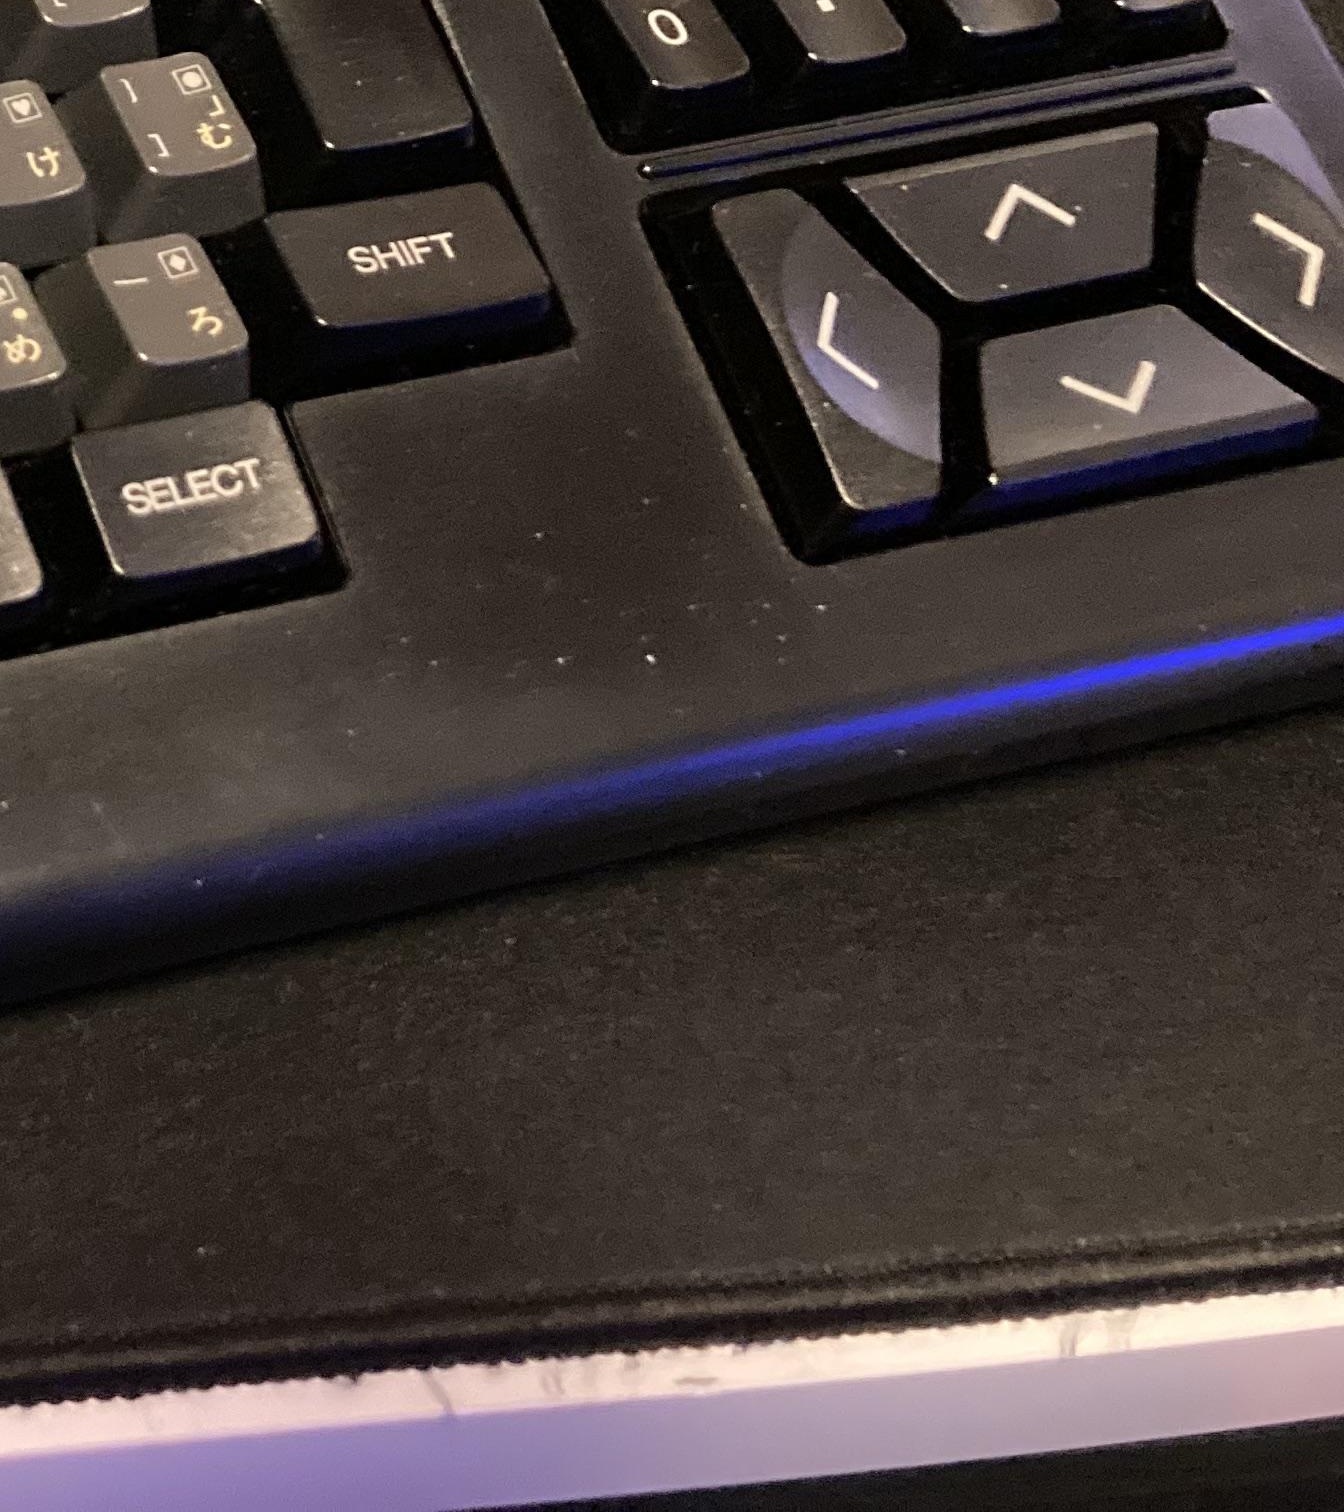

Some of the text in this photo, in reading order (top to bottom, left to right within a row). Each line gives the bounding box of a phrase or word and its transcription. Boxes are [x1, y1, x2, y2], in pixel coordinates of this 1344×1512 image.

[648, 10, 688, 45] 0
[348, 231, 456, 275] SHIFT
[122, 458, 264, 515] SELECT
